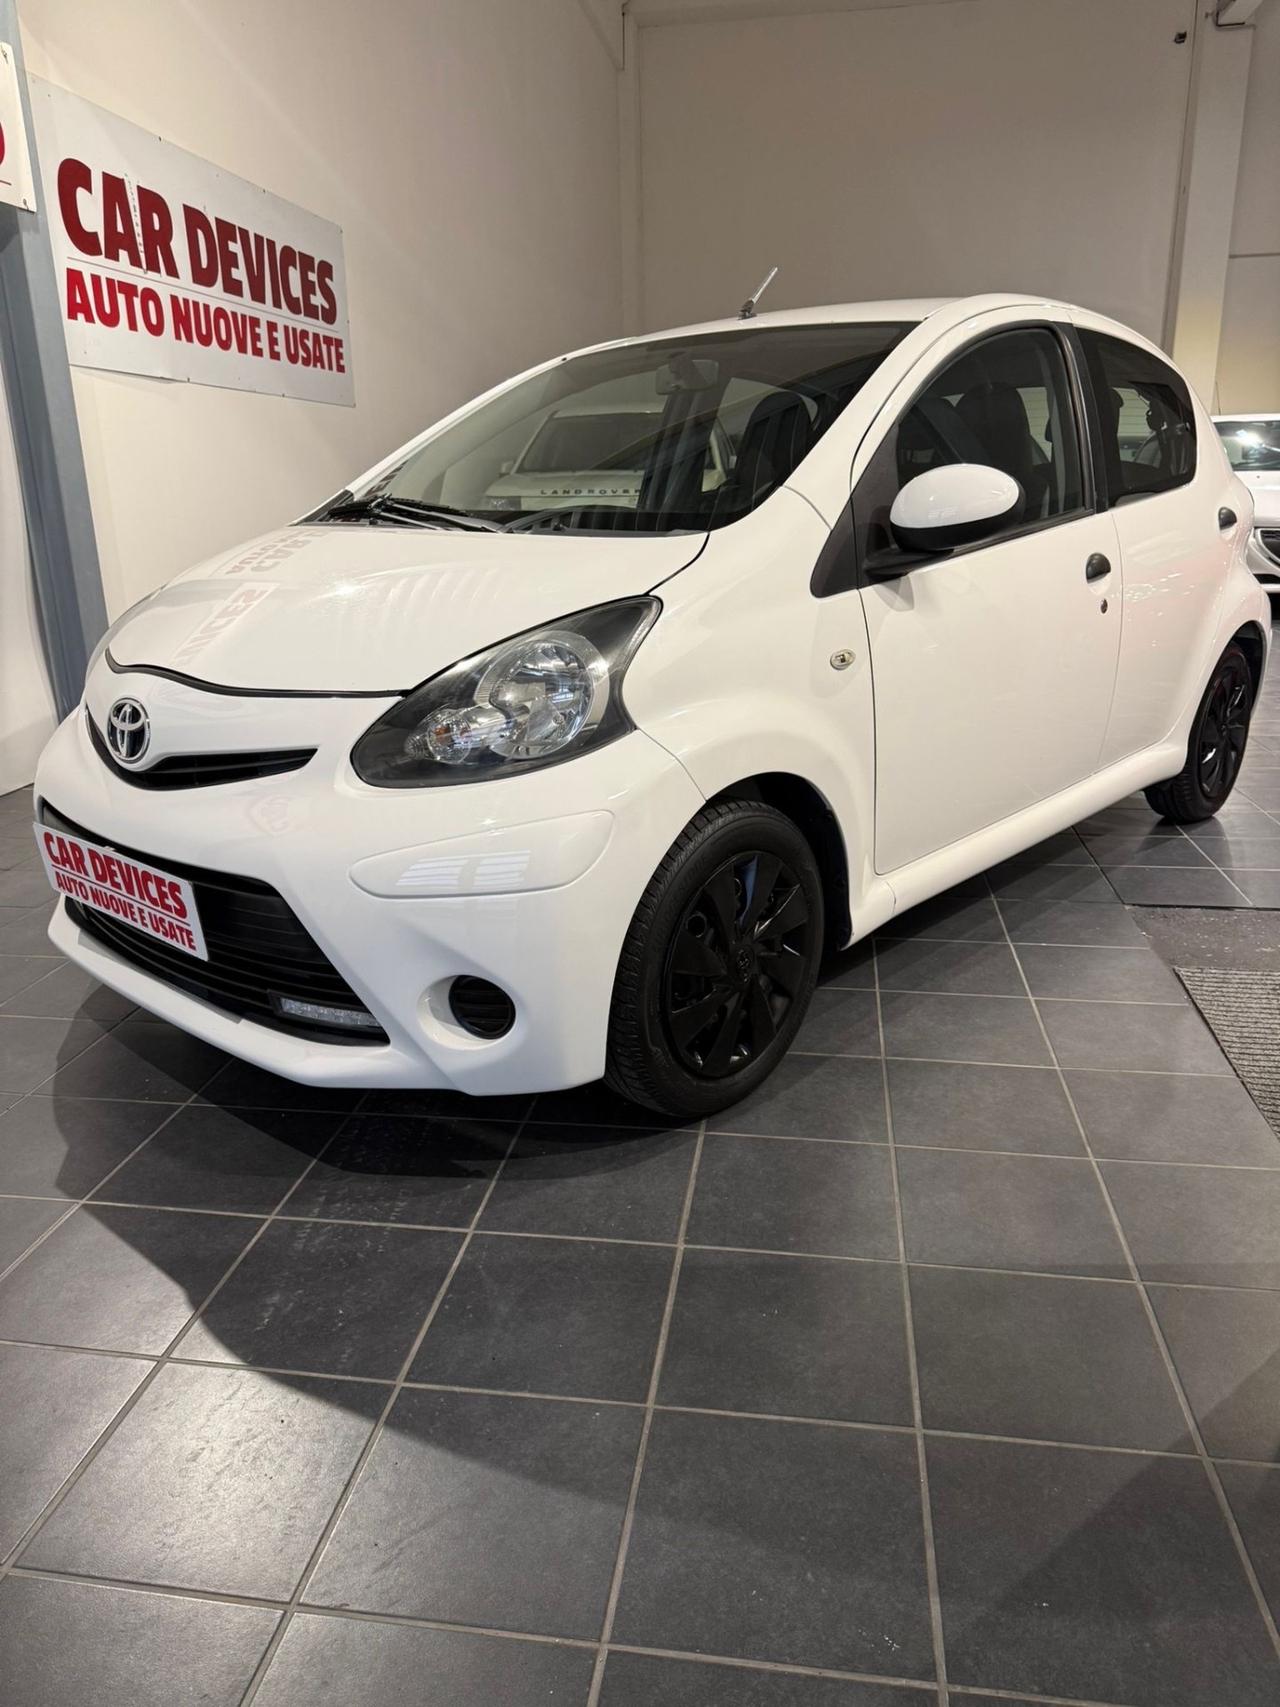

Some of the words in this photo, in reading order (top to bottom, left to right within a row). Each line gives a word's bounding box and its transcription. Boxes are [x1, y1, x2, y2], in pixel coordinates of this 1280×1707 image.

[57, 158, 180, 279] CAR
[182, 203, 338, 325] DEVICES
[66, 267, 165, 337] AUTO
[170, 294, 263, 358] NUOVE
[266, 320, 281, 361] E
[283, 325, 346, 373] USATE
[43, 831, 89, 877] CAR
[87, 847, 188, 919] DEVICES
[55, 871, 88, 901] AUTO
[90, 888, 138, 923] NUOVE
[137, 906, 149, 928] E
[147, 911, 197, 951] USATE
